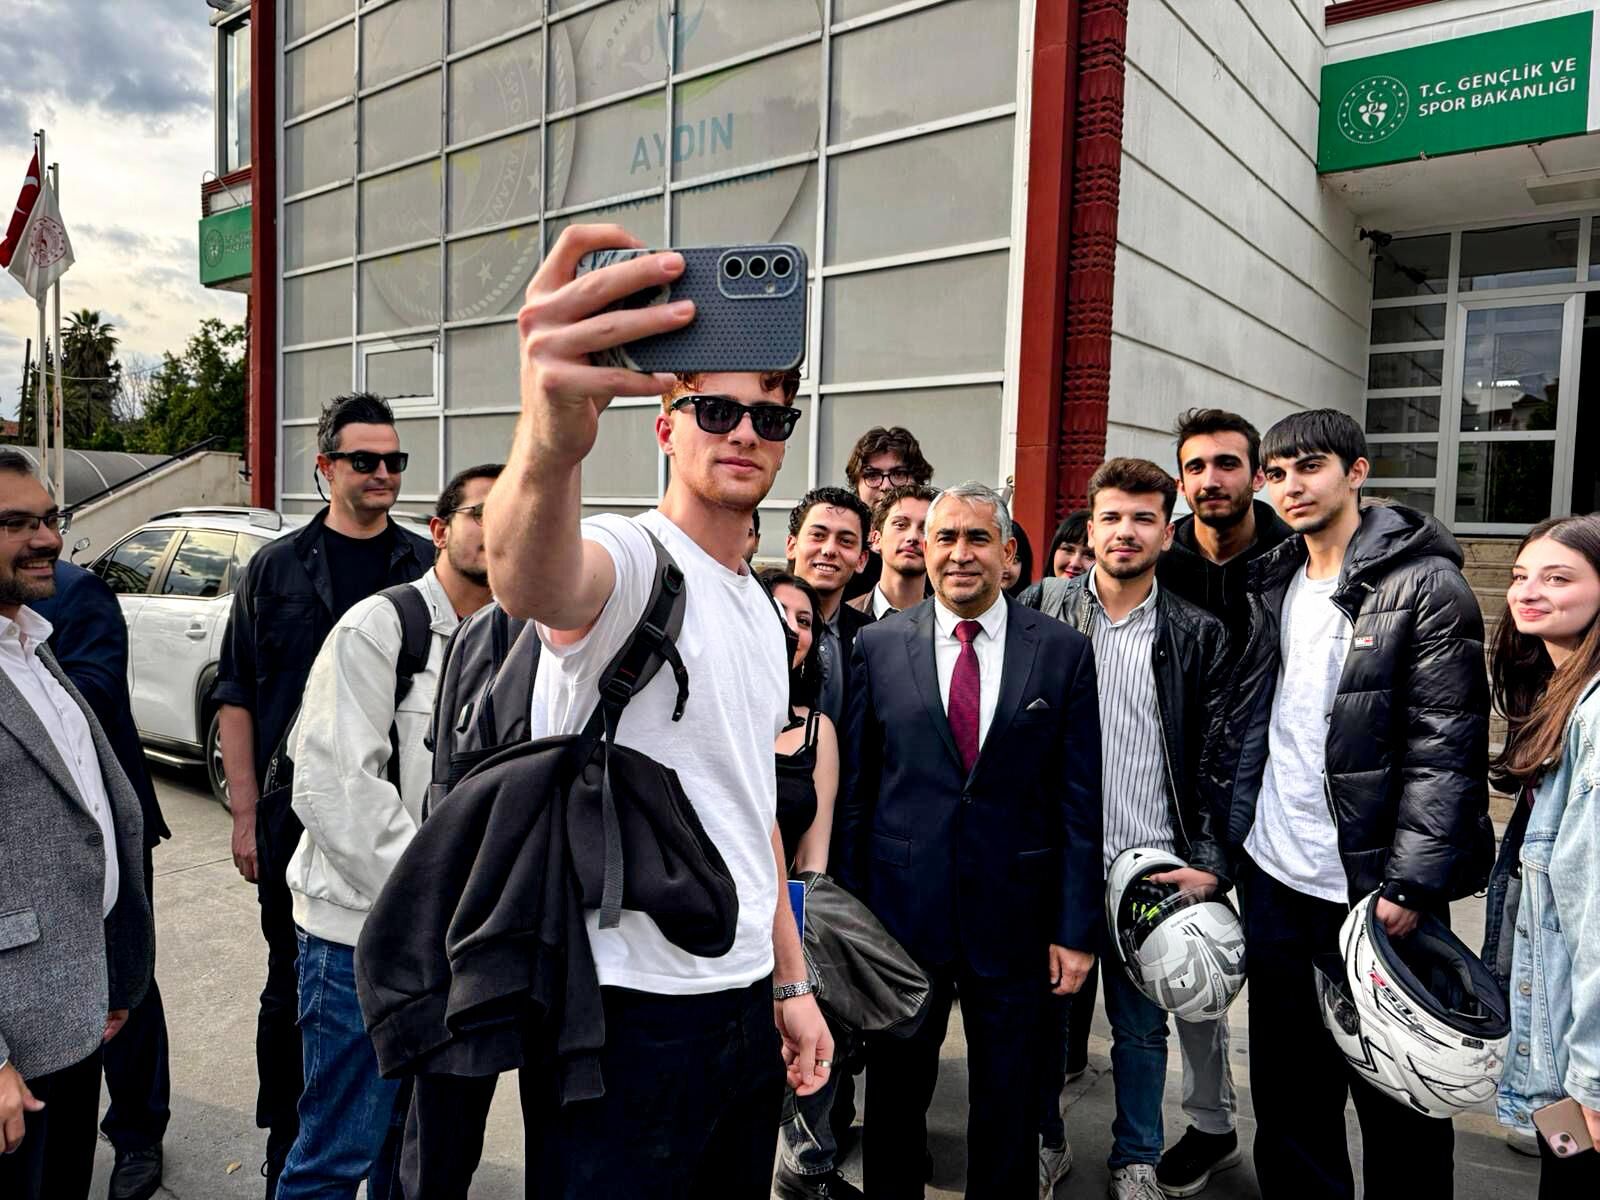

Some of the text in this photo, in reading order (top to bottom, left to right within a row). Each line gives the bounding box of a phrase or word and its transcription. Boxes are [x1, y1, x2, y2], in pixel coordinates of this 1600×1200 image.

[1418, 76, 1576, 117] SPOR BAKANLIĞI
[1419, 57, 1577, 97] T.C. GENÇLİK VE
[629, 111, 734, 176] AYDIN
